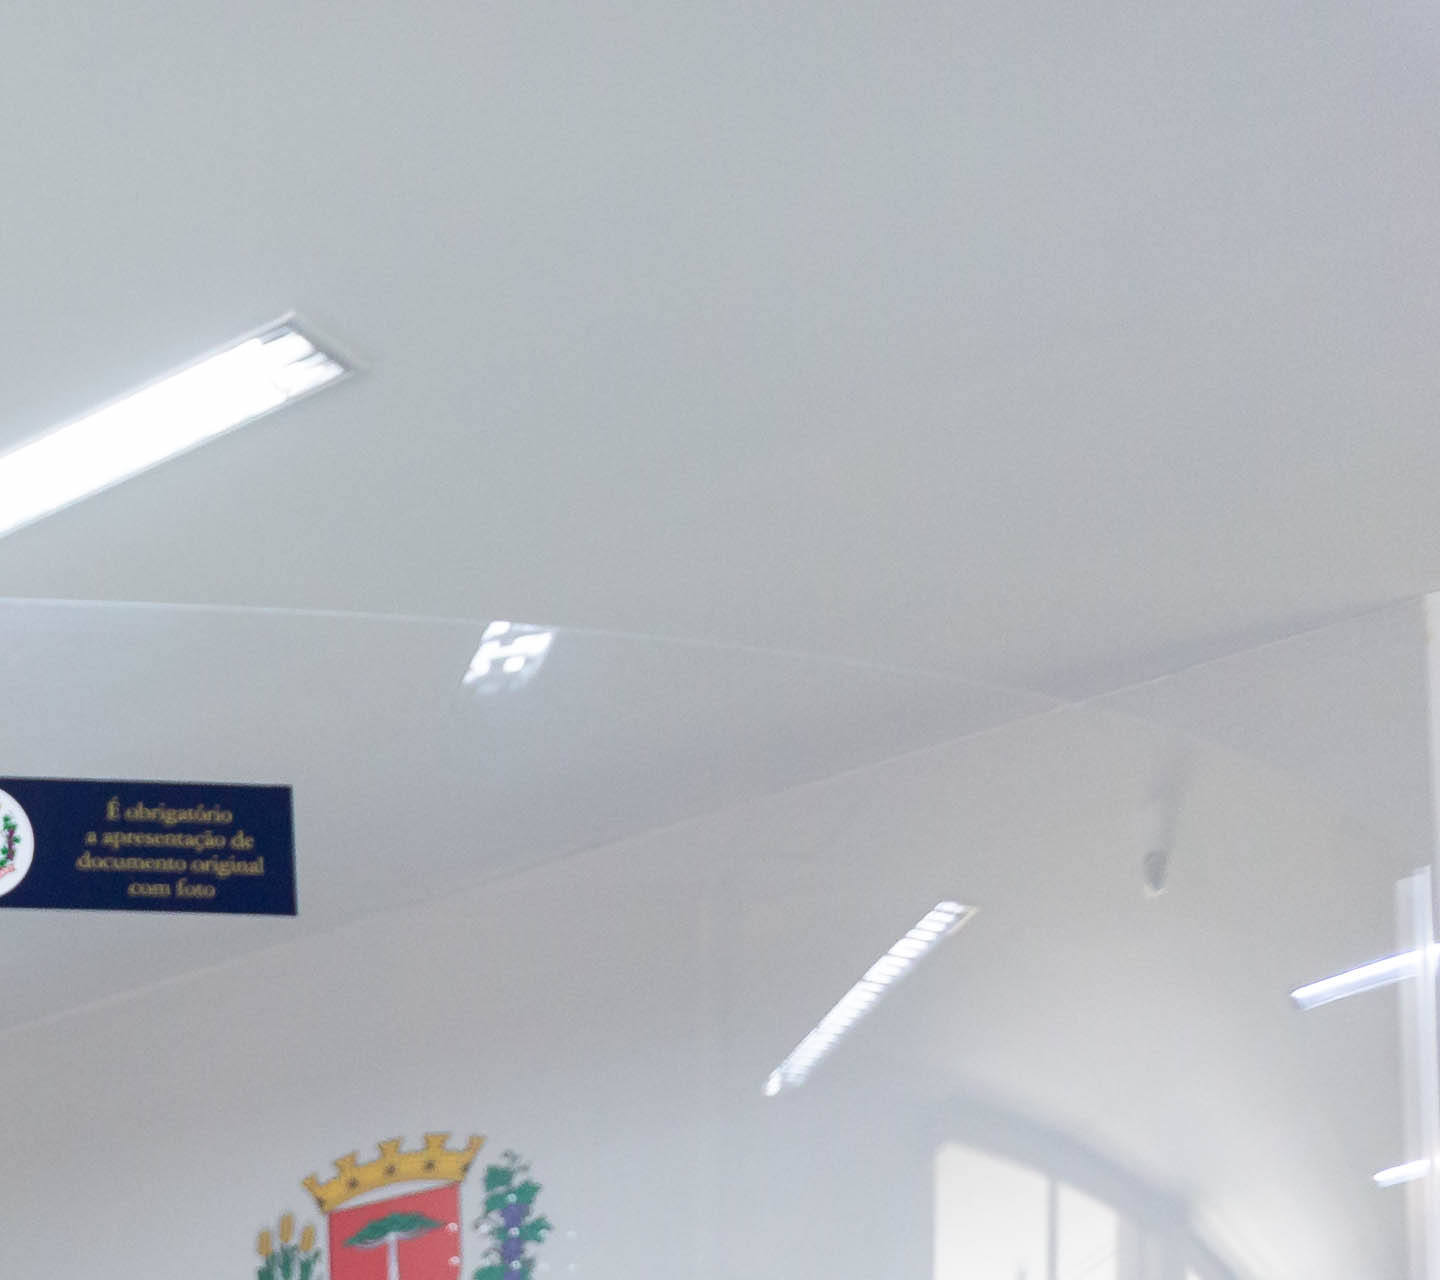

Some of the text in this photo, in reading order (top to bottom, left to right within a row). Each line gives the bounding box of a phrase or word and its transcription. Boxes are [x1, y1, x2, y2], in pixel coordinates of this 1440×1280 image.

[124, 801, 233, 826] obrigatório
[86, 829, 254, 850] a apresentação de
[76, 850, 265, 879] documento original
[128, 877, 217, 898] com foto
